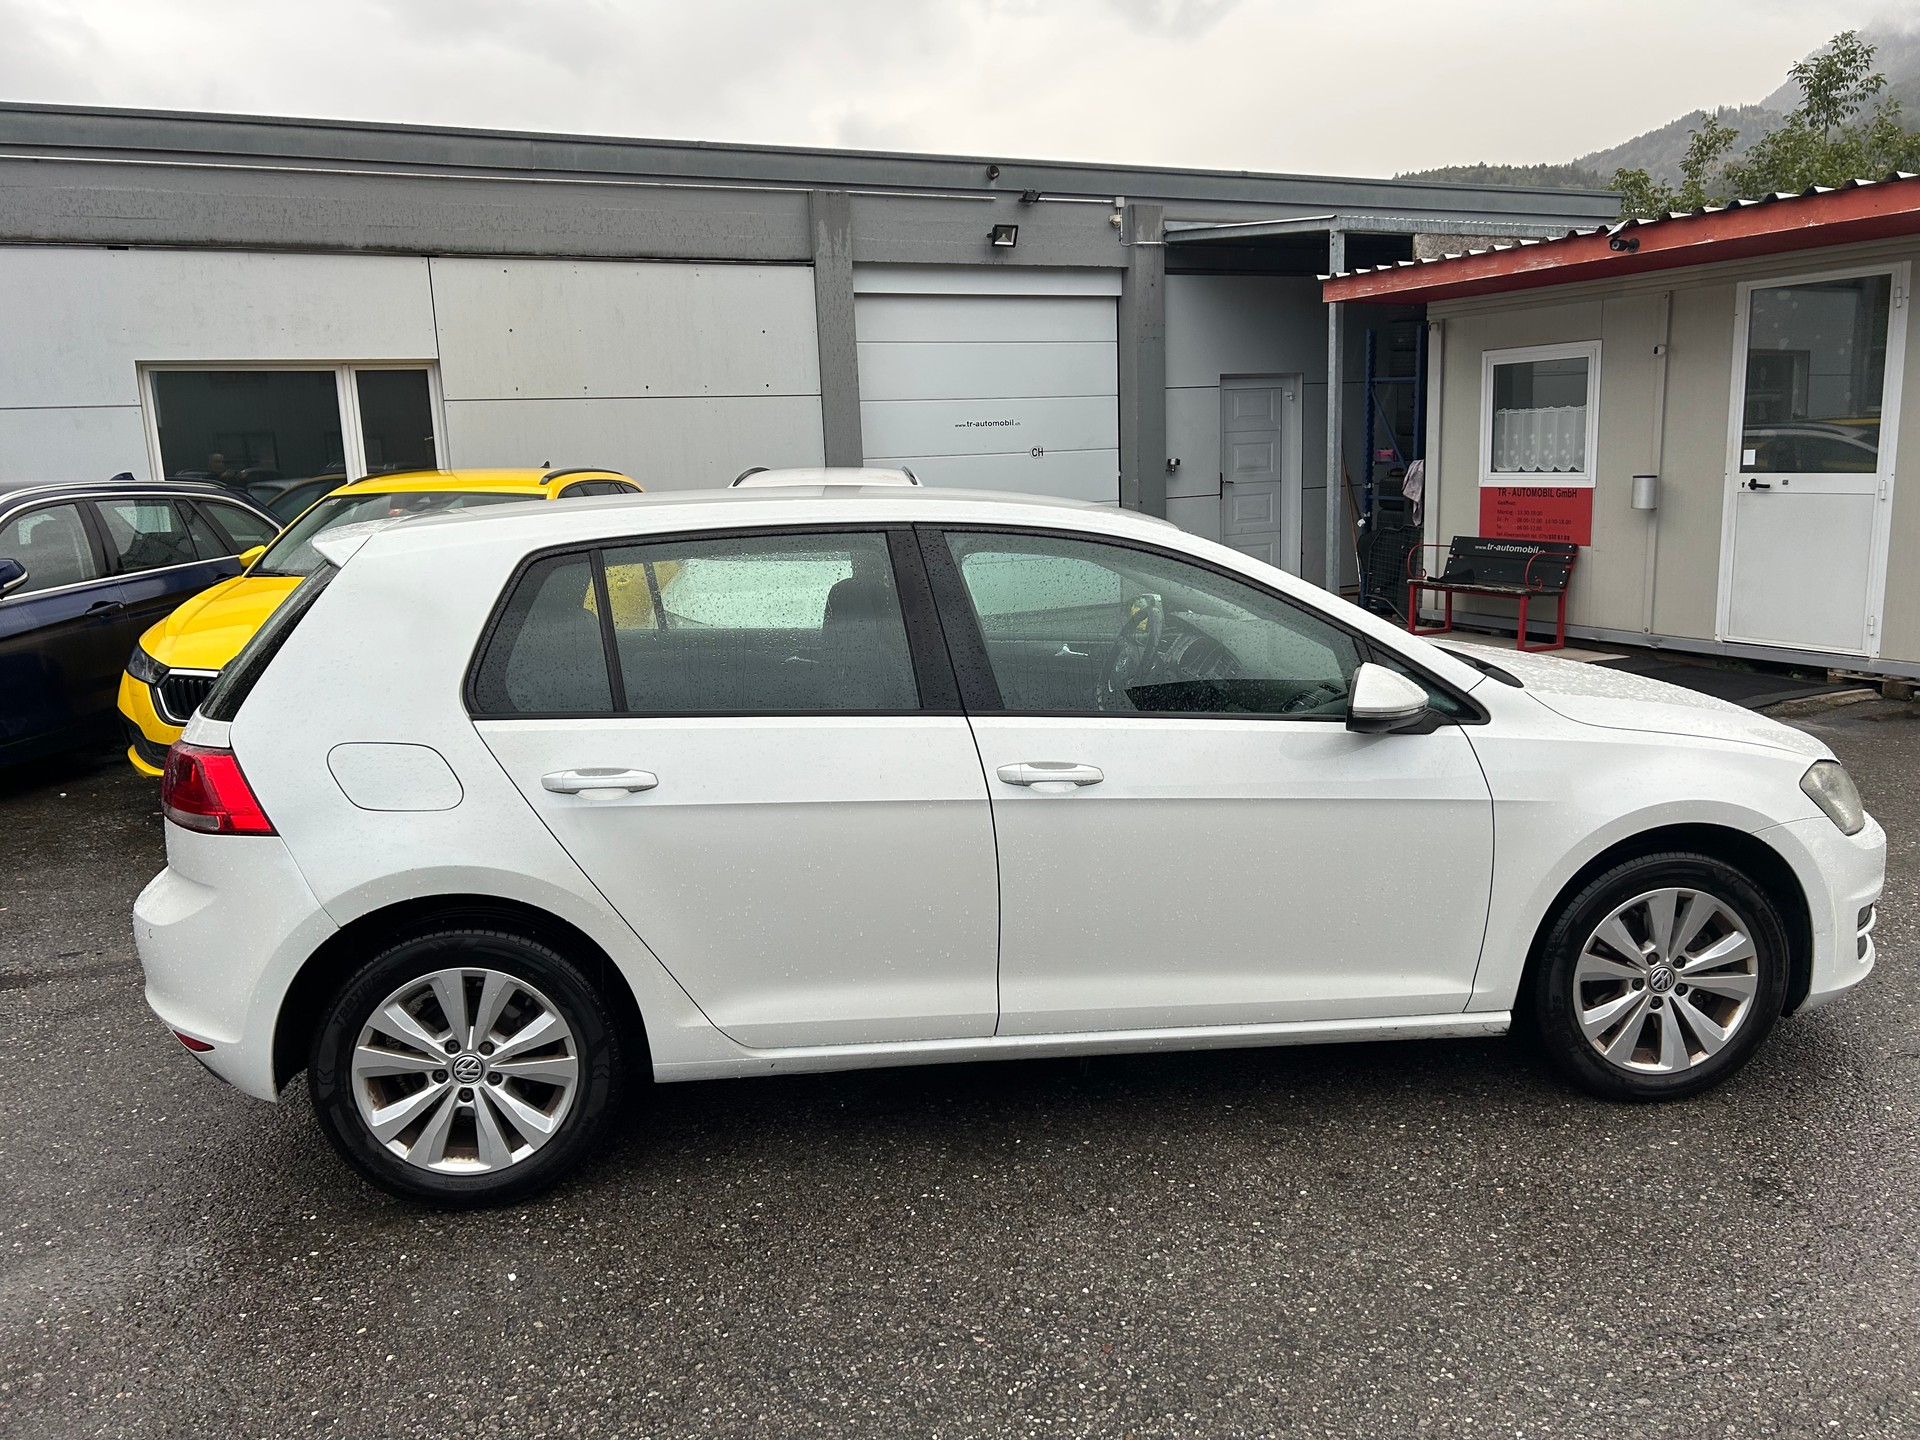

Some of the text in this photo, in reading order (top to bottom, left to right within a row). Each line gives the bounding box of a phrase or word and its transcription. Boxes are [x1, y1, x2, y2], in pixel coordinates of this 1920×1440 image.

[1031, 447, 1044, 457] CH
[1497, 488, 1507, 497] TR
[1512, 488, 1554, 498] AUTOMOBIL
[1556, 488, 1577, 498] GmbH
